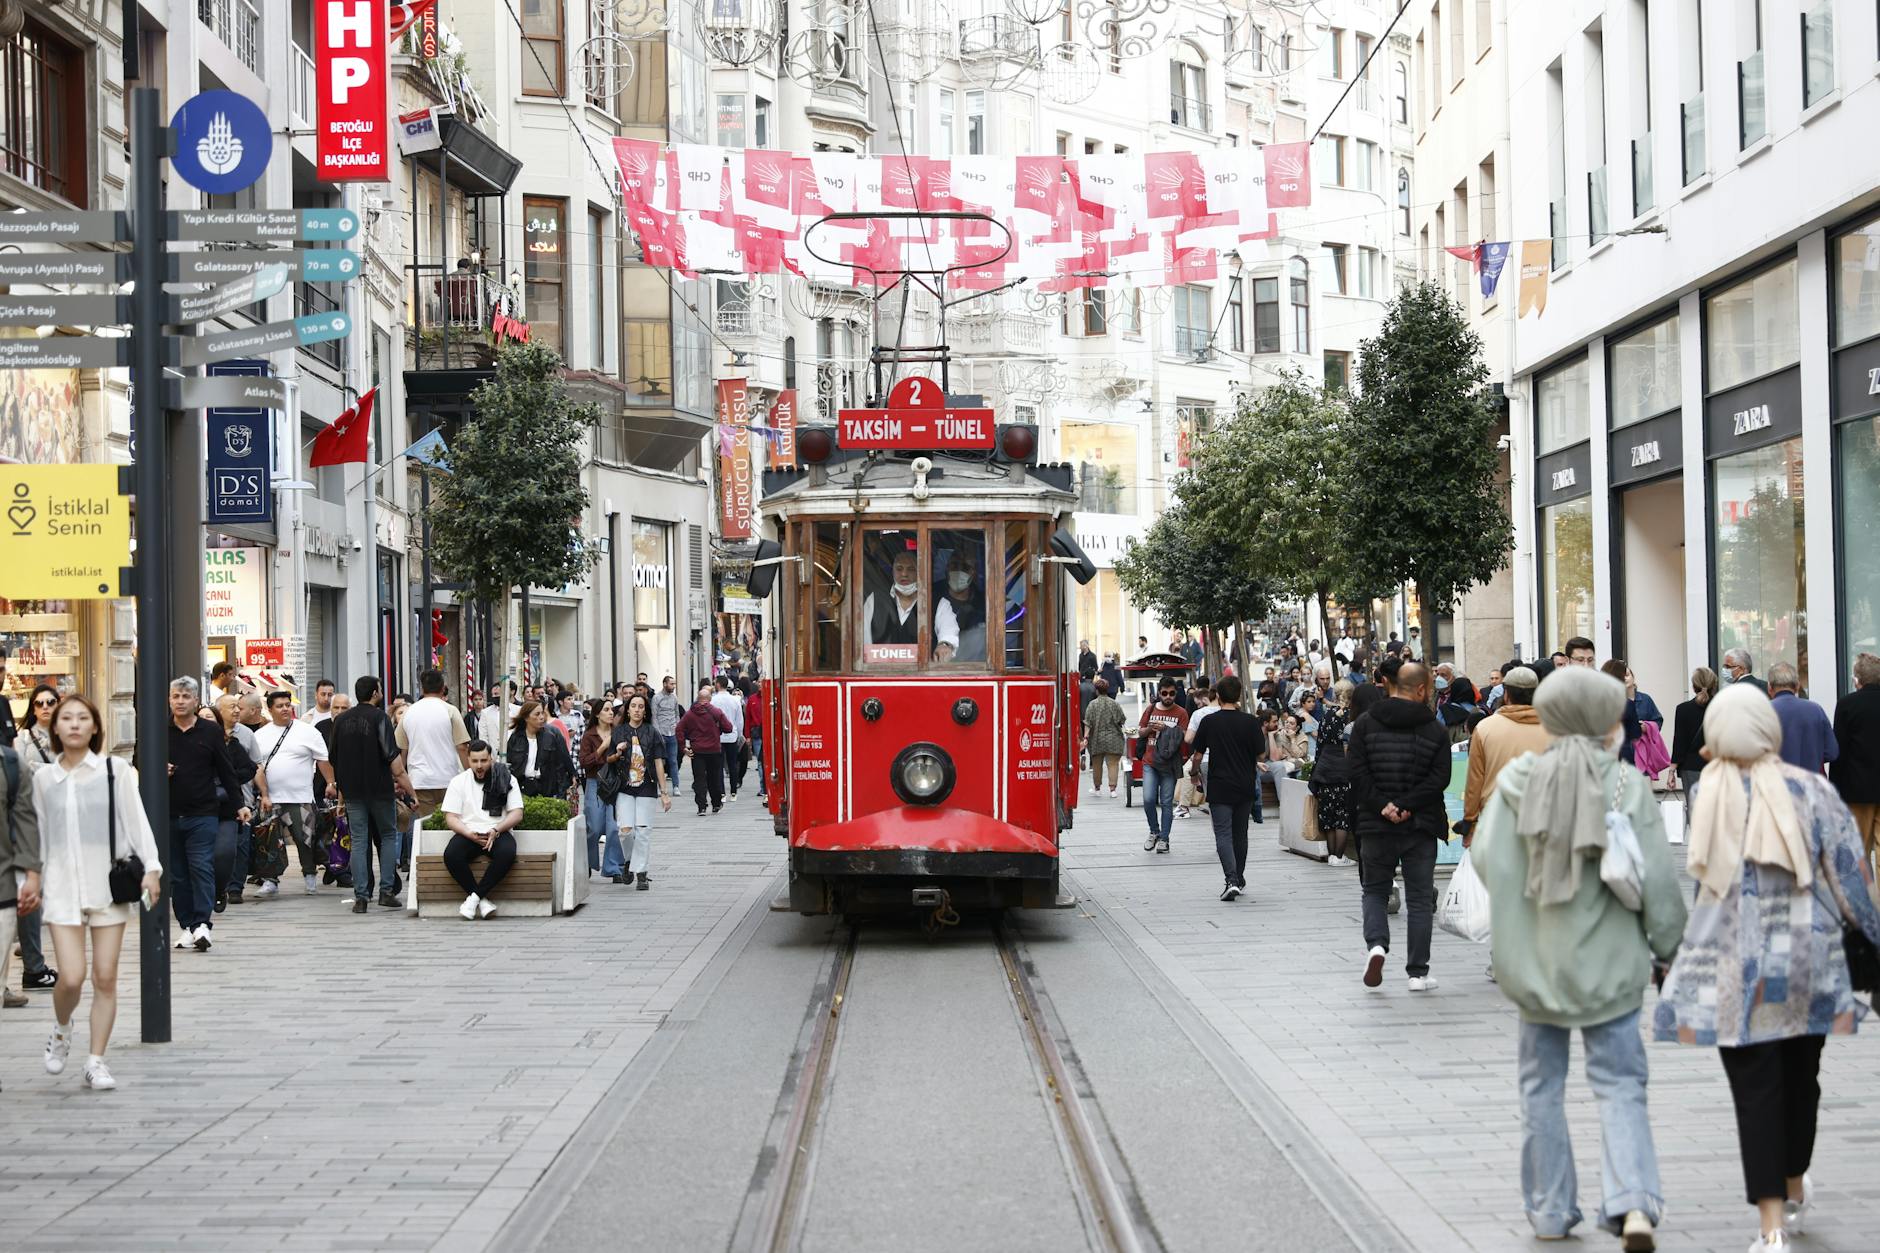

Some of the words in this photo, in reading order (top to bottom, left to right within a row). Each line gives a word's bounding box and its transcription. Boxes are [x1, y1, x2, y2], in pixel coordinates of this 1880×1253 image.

[423, 7, 436, 57] ERAS
[331, 120, 373, 133] BEYOĞLU
[342, 136, 362, 151] İLÇE
[325, 152, 380, 168] BAŞKANLIĞI
[184, 214, 204, 225] Yapı
[207, 213, 234, 223] Kredi
[236, 213, 265, 223] Kültür
[268, 213, 296, 223] Sanat
[307, 220, 318, 229] 40
[51, 222, 79, 235] Pasajı
[257, 226, 296, 235] Merkezi
[0, 265, 33, 276] Avrupa
[35, 264, 74, 276] (Aynalı)
[76, 264, 104, 276] Pasajı
[195, 262, 252, 273] Galatasaray
[307, 262, 318, 270] 70
[0, 306, 25, 319] Çiçek
[27, 306, 55, 318] Pasajı
[208, 336, 265, 352] Galatasaray
[265, 329, 292, 343] Lisesi
[0, 354, 81, 367] Başkonsolosluğu
[245, 387, 268, 398] Atlas
[909, 380, 922, 405] 2
[1734, 404, 1771, 435] ZARA
[844, 415, 902, 440] TAKSİM
[934, 414, 986, 440] TÜNEL
[1631, 441, 1661, 467] ZARA
[219, 475, 259, 495] D'S
[1552, 468, 1576, 491] ZARA
[734, 458, 750, 529] SÜRÜCÜ
[48, 496, 109, 515] İstiklal
[220, 497, 259, 506] damat
[48, 519, 101, 535] Senin
[51, 568, 102, 577] istiklal.ist
[871, 647, 914, 658] TÜNEL
[798, 705, 813, 725] 223
[1031, 704, 1046, 724] 223
[812, 760, 831, 768] YASAK
[1017, 772, 1025, 780] VE
